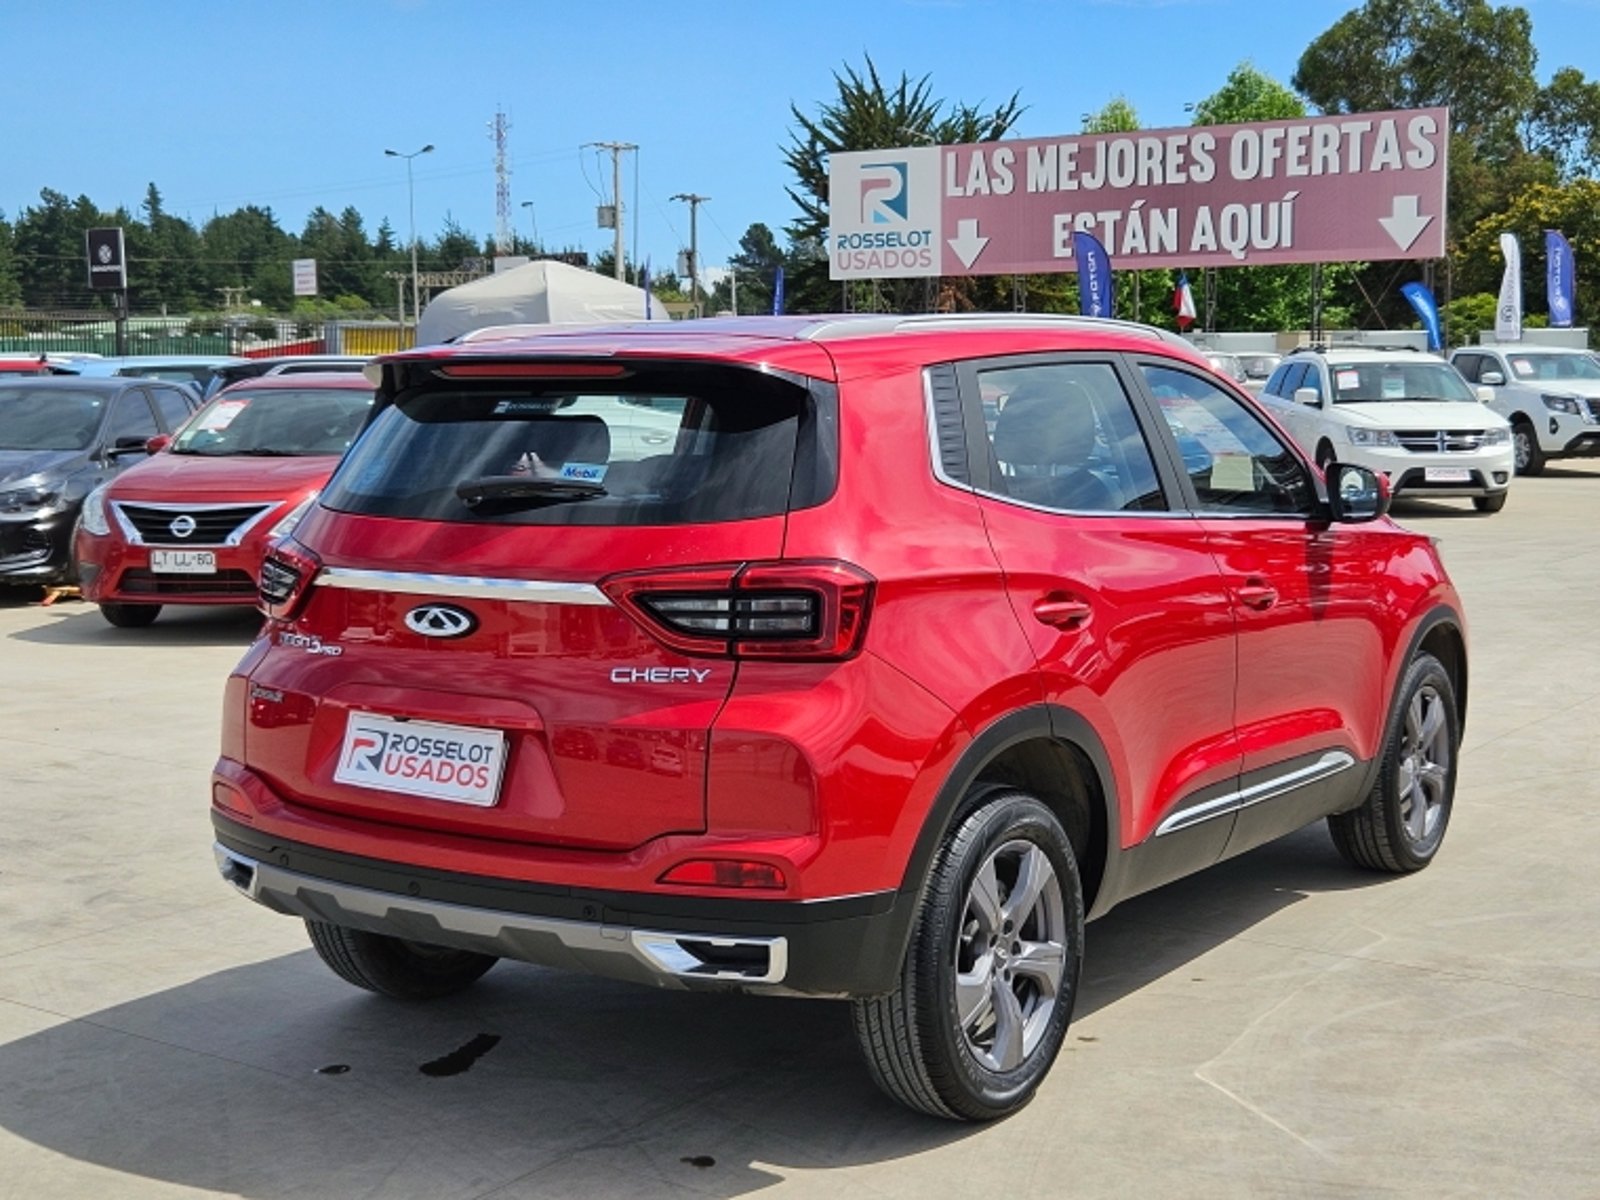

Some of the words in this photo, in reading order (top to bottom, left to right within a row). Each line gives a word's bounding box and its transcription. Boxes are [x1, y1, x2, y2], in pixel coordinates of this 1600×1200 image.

[946, 147, 1015, 197] LAS
[1027, 132, 1216, 193] MEJORES
[1230, 115, 1438, 180] OFERTAS
[837, 230, 932, 249] ROSSELOT
[1190, 191, 1301, 260] AQUÍ
[837, 249, 932, 271] USADOS
[610, 667, 711, 683] CHERY
[389, 734, 494, 765] ROSSELOT
[384, 753, 490, 789] USADOS
